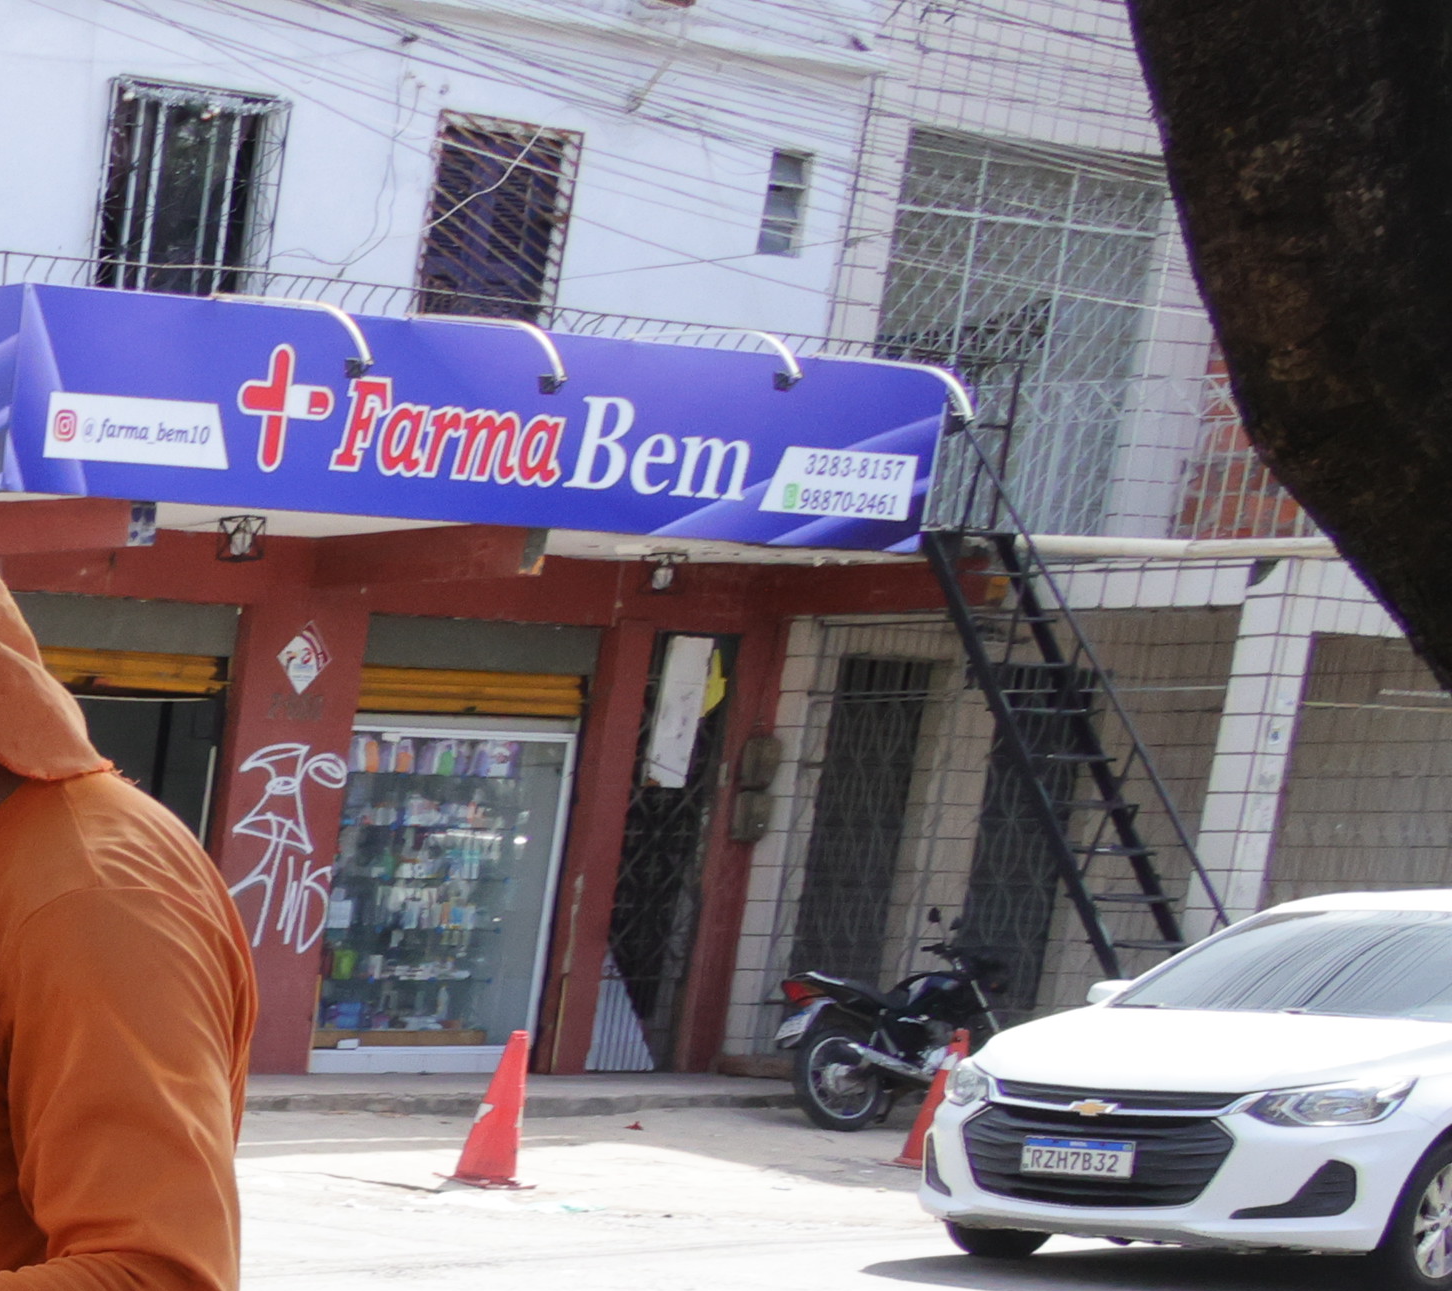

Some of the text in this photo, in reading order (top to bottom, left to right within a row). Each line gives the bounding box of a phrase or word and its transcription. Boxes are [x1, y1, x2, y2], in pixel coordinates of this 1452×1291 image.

[328, 376, 750, 501] Farma Bem
[804, 453, 906, 481] 3283-8157
[799, 488, 897, 515] 98870-2461
[1030, 1148, 1119, 1173] RZH7B32
